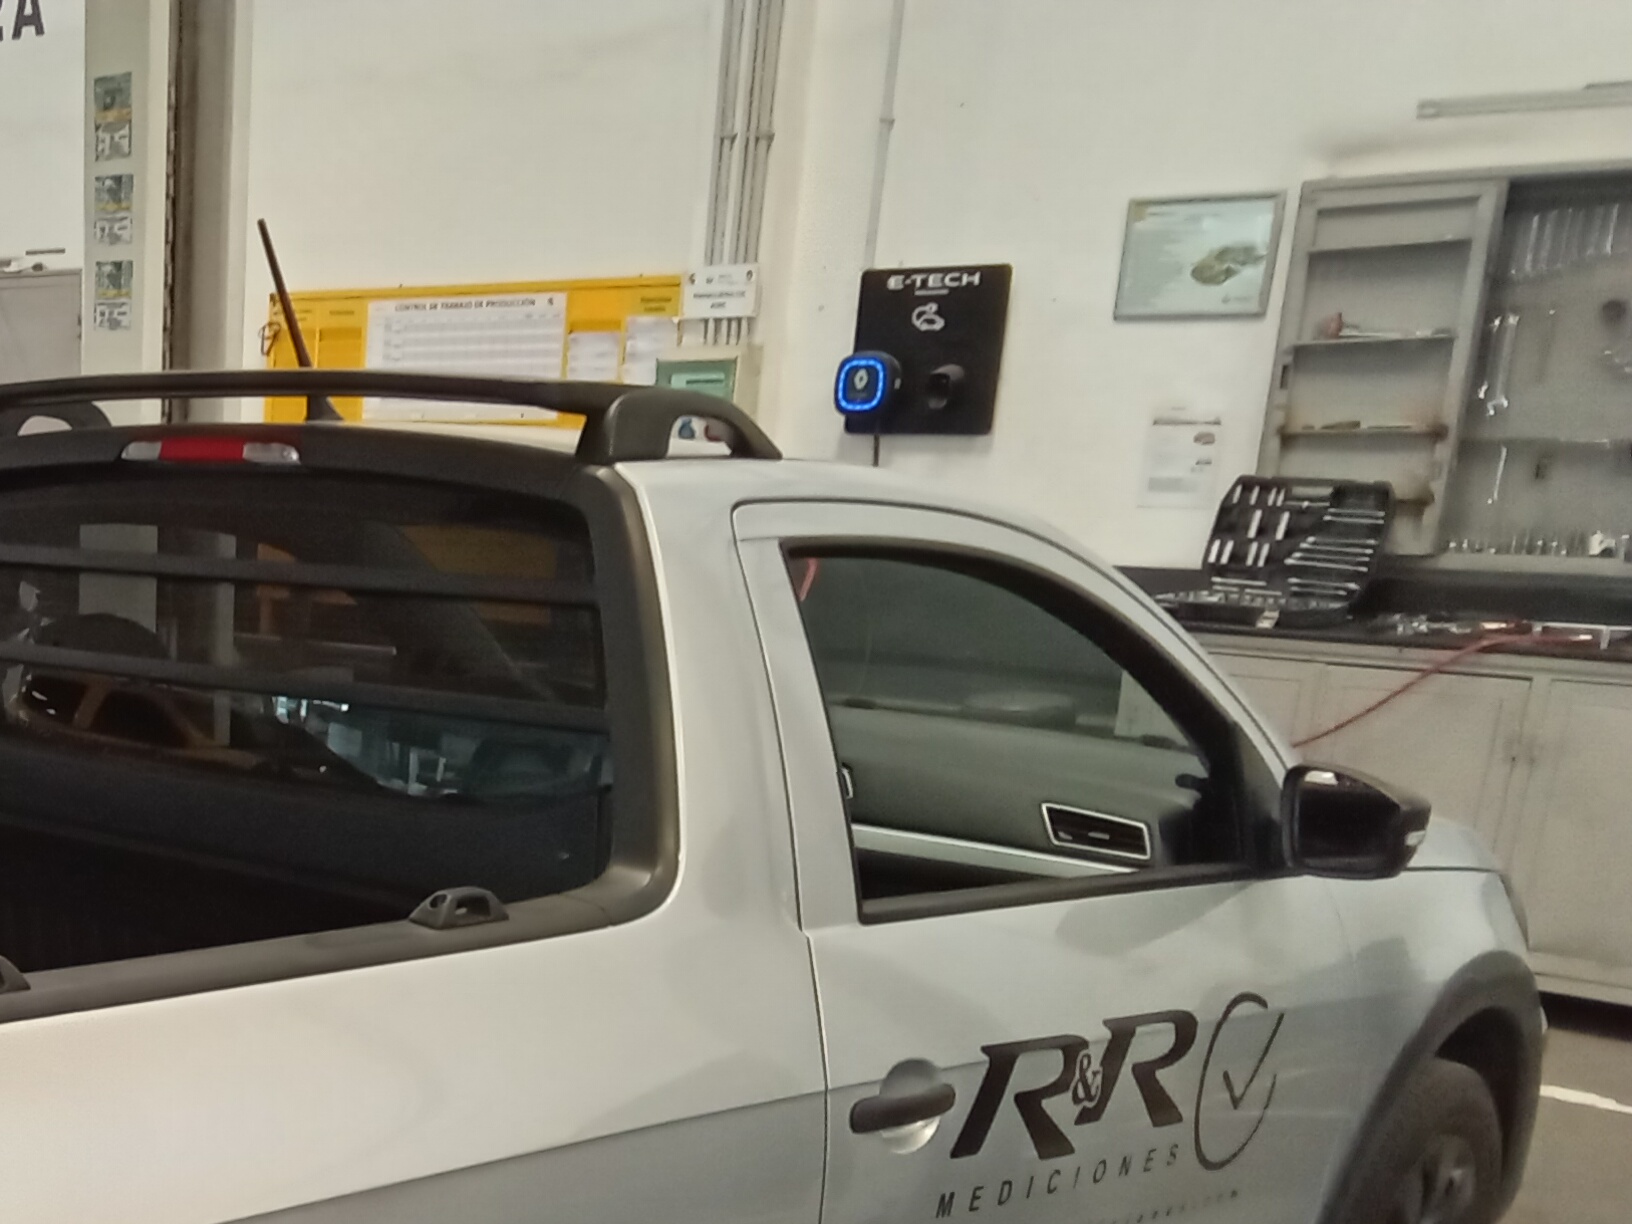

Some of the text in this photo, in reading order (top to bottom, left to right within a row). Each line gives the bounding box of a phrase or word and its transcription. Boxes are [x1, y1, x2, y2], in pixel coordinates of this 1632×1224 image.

[886, 271, 981, 291] E-TECH
[949, 1009, 1199, 1160] R&R
[935, 1142, 1180, 1219] MEDICIONES
